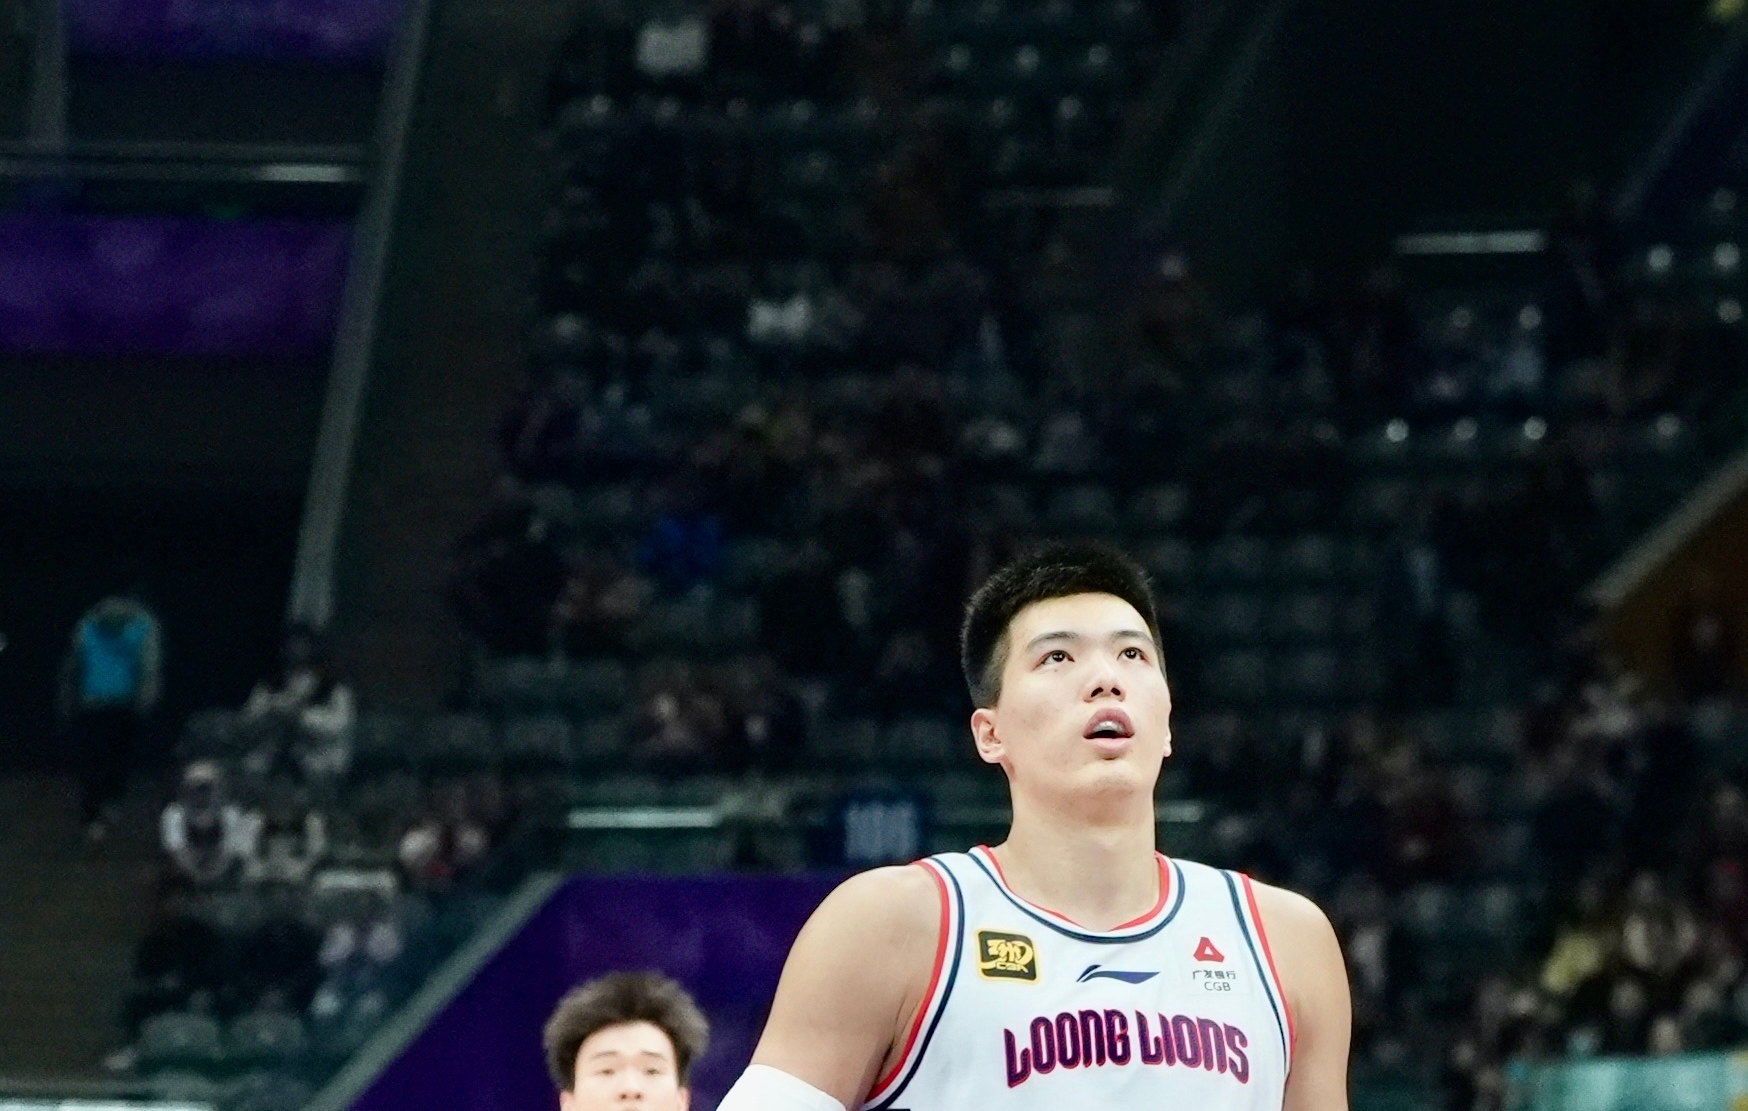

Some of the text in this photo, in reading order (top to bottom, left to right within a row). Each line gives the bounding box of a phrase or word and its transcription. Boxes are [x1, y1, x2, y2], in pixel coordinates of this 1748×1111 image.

[1204, 981, 1232, 992] CGB
[1003, 1009, 1250, 1089] LOONG LIONS
